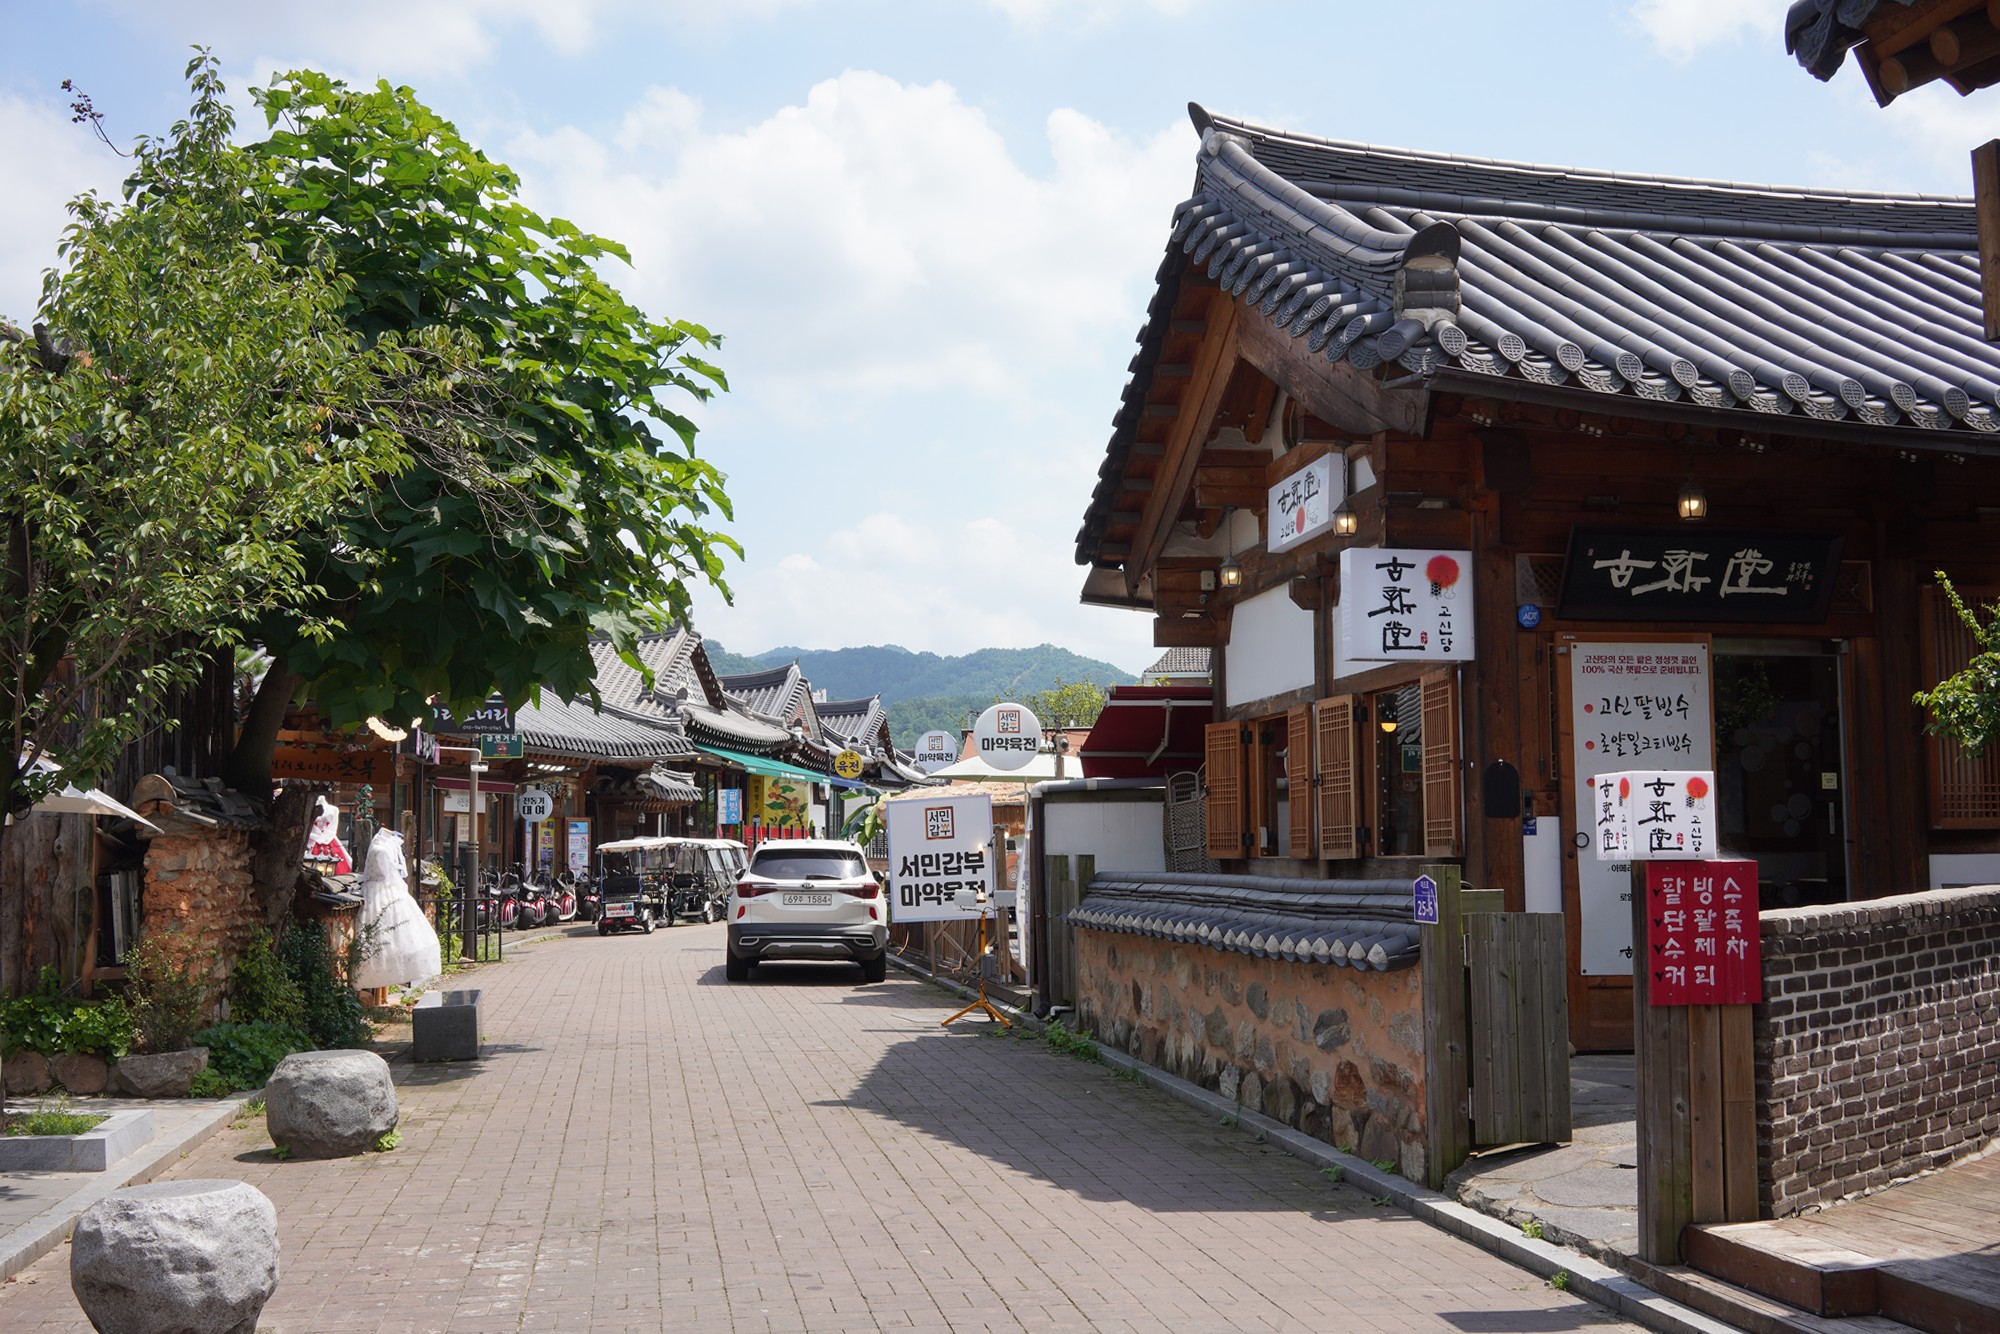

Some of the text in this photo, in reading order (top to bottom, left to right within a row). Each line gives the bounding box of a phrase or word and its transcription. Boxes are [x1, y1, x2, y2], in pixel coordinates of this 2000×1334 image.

[1522, 612, 1538, 620] ADT
[1438, 606, 1453, 653] 고신당
[1583, 655, 1616, 664] 고신당의
[1618, 655, 1634, 664] 모든
[1581, 665, 1605, 674] 100%
[1607, 666, 1624, 675] 국산
[1626, 665, 1658, 675] 햇팥으로
[1000, 712, 1017, 721] 서민
[981, 737, 1037, 752] 마약육전
[918, 752, 954, 762] 마약육전
[836, 760, 860, 773] 육전
[929, 810, 950, 823] 서민
[929, 823, 951, 837] 갑부
[1691, 815, 1703, 852] 고신당
[898, 851, 985, 878] 서민갑부
[1662, 877, 1743, 906] 팥빙수
[807, 895, 828, 904] 1584
[1663, 908, 1744, 933] 단팥죽
[1664, 936, 1749, 960] 수제차
[1664, 965, 1717, 987] 커피
